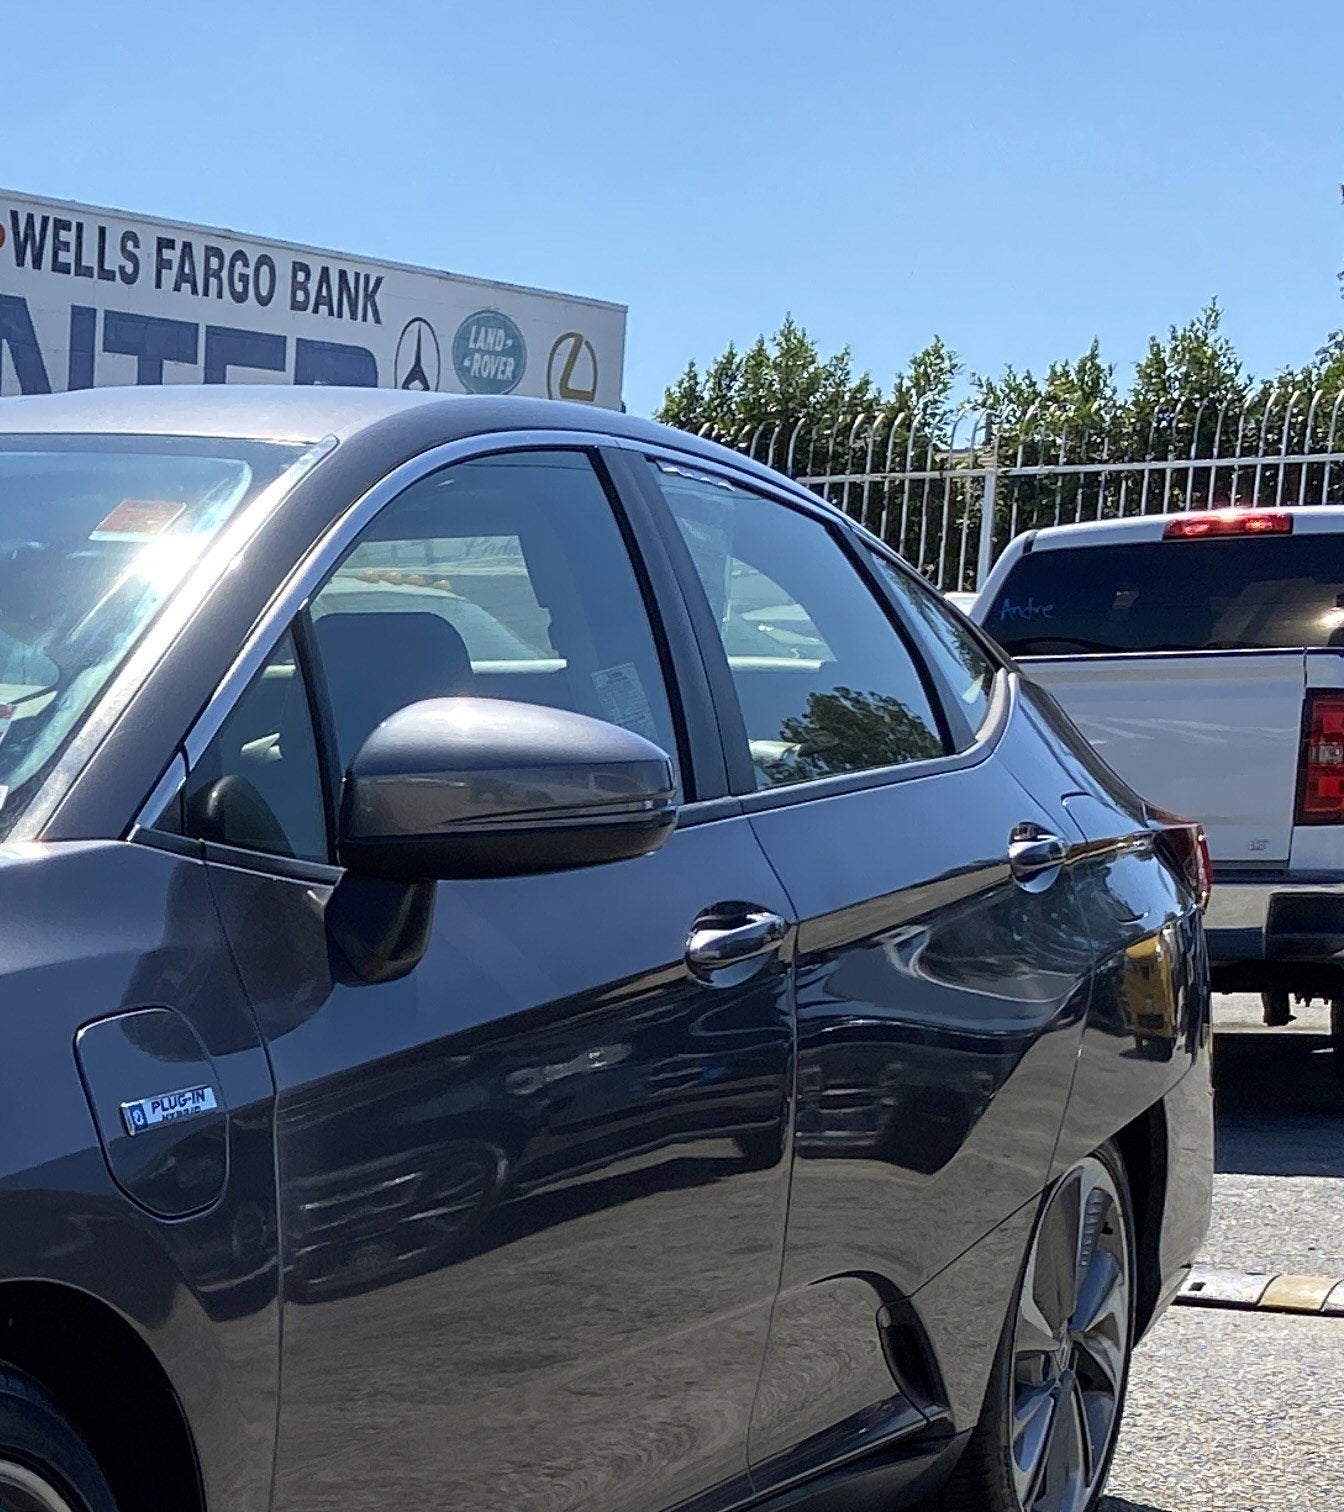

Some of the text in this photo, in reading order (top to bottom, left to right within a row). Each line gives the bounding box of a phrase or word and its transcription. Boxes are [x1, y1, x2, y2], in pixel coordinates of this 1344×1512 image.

[10, 209, 140, 285] WELLS
[155, 236, 276, 307] FARGO
[290, 260, 384, 324] BANK
[469, 325, 506, 350] LAND
[470, 353, 515, 380] ROVER
[151, 1089, 206, 1114] PLUG-IN
